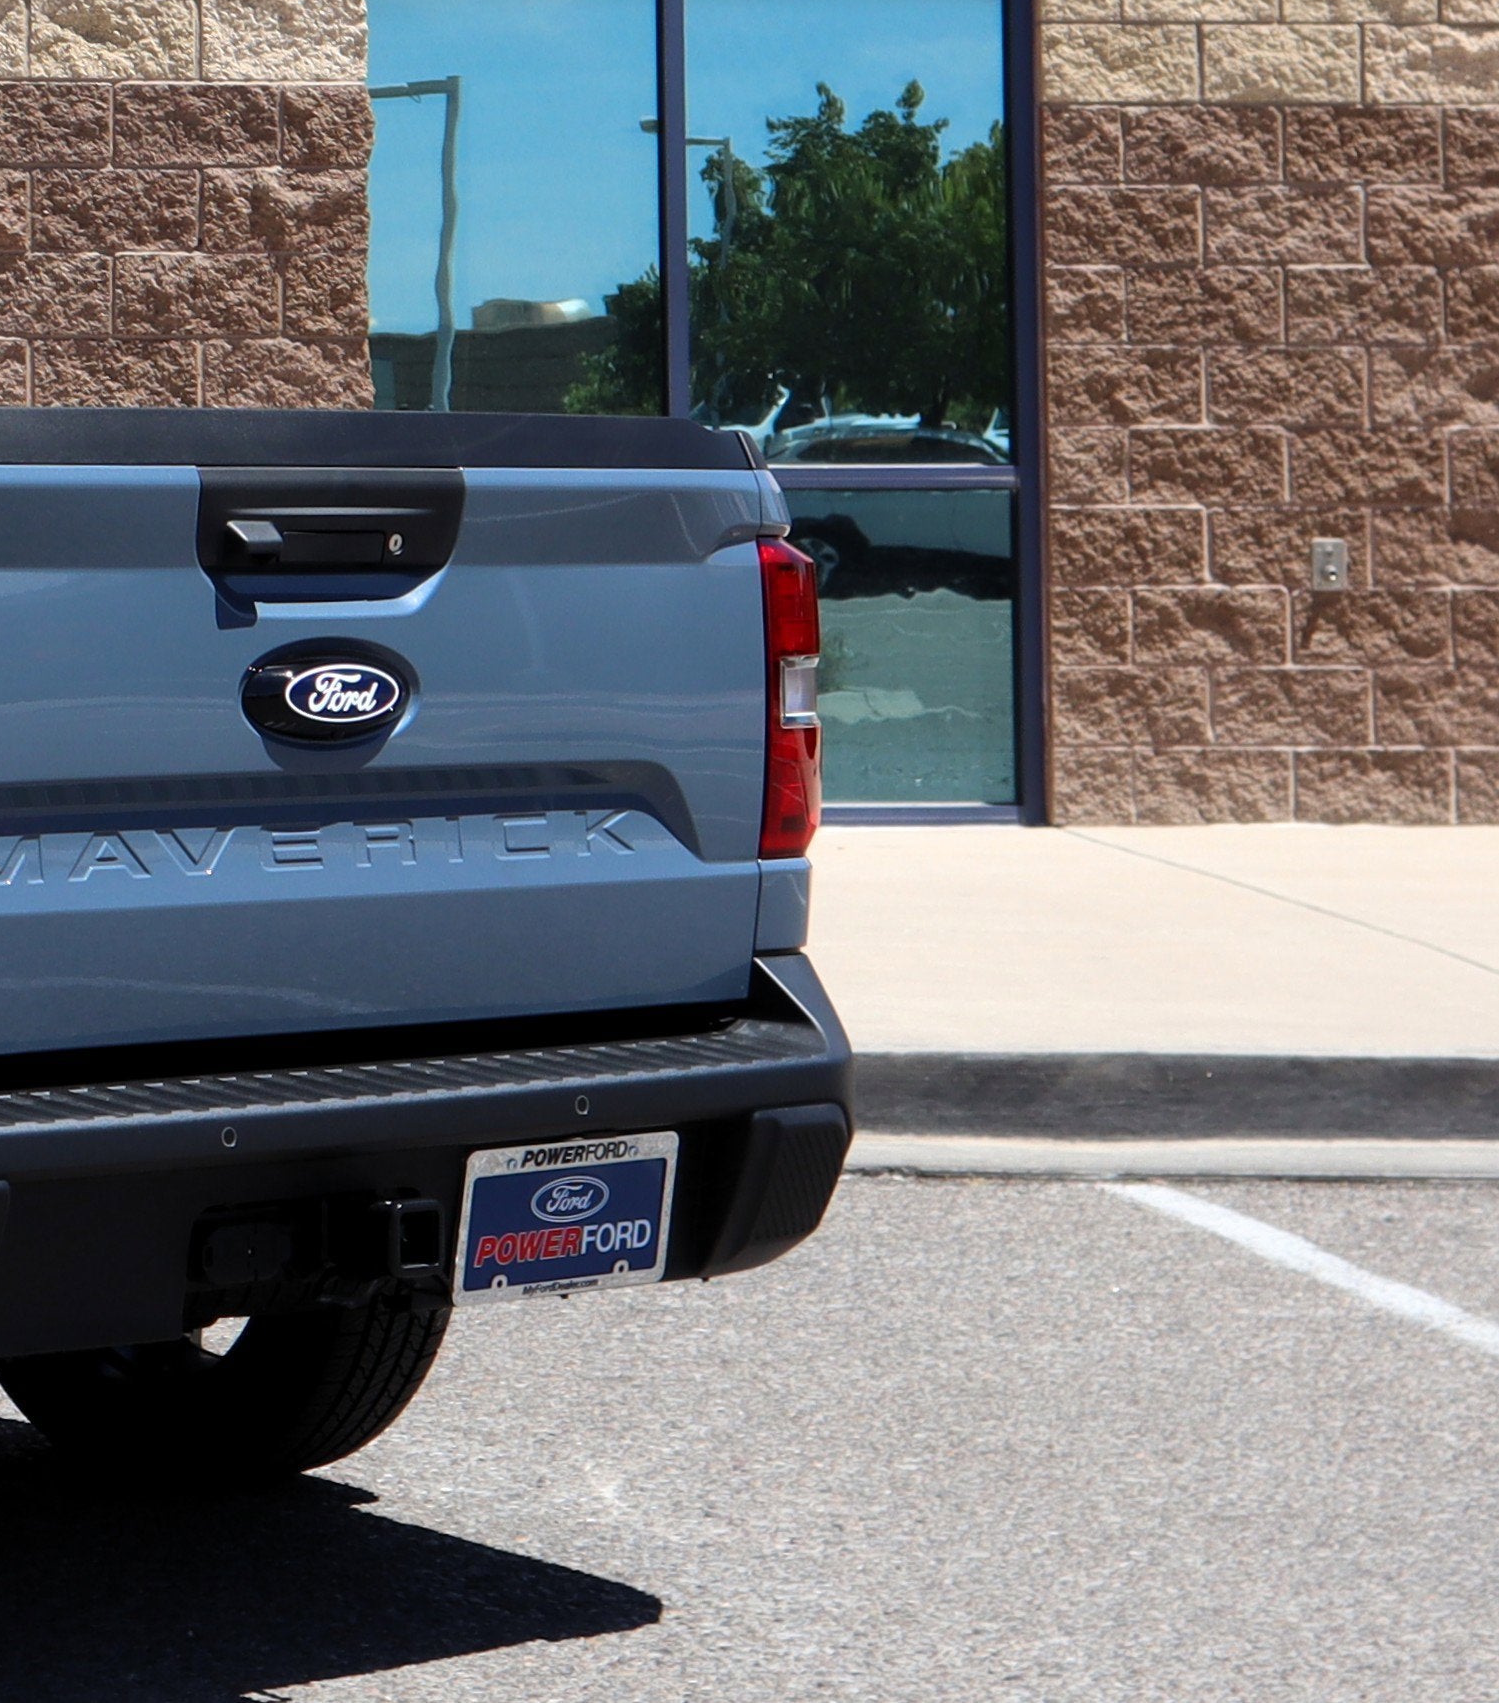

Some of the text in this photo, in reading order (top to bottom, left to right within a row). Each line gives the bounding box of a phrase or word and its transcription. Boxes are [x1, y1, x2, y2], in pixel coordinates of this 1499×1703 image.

[307, 672, 379, 712] Ford
[545, 1184, 595, 1213] Ford
[522, 1277, 599, 1297] MyFordDealer.com
